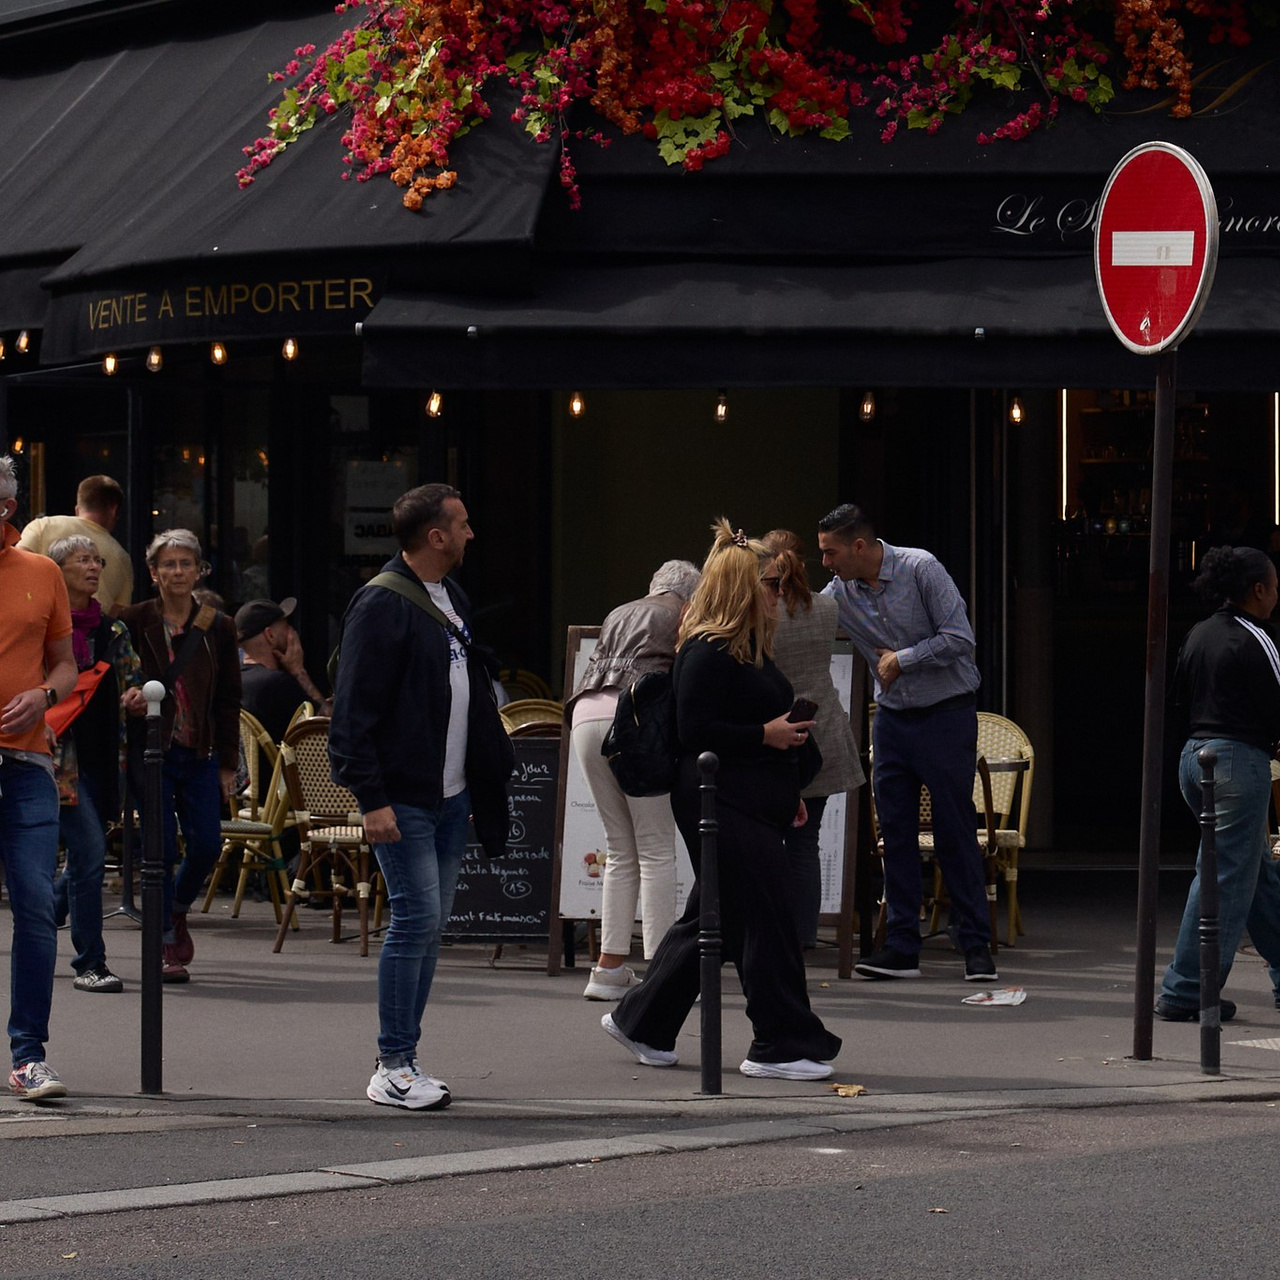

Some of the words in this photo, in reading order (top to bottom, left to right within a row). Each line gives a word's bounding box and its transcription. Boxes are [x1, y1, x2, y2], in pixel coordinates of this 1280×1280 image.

[990, 193, 1046, 236] Le
[89, 292, 148, 330] VENTE
[158, 289, 174, 320] A
[185, 277, 375, 317] EMPORTER
